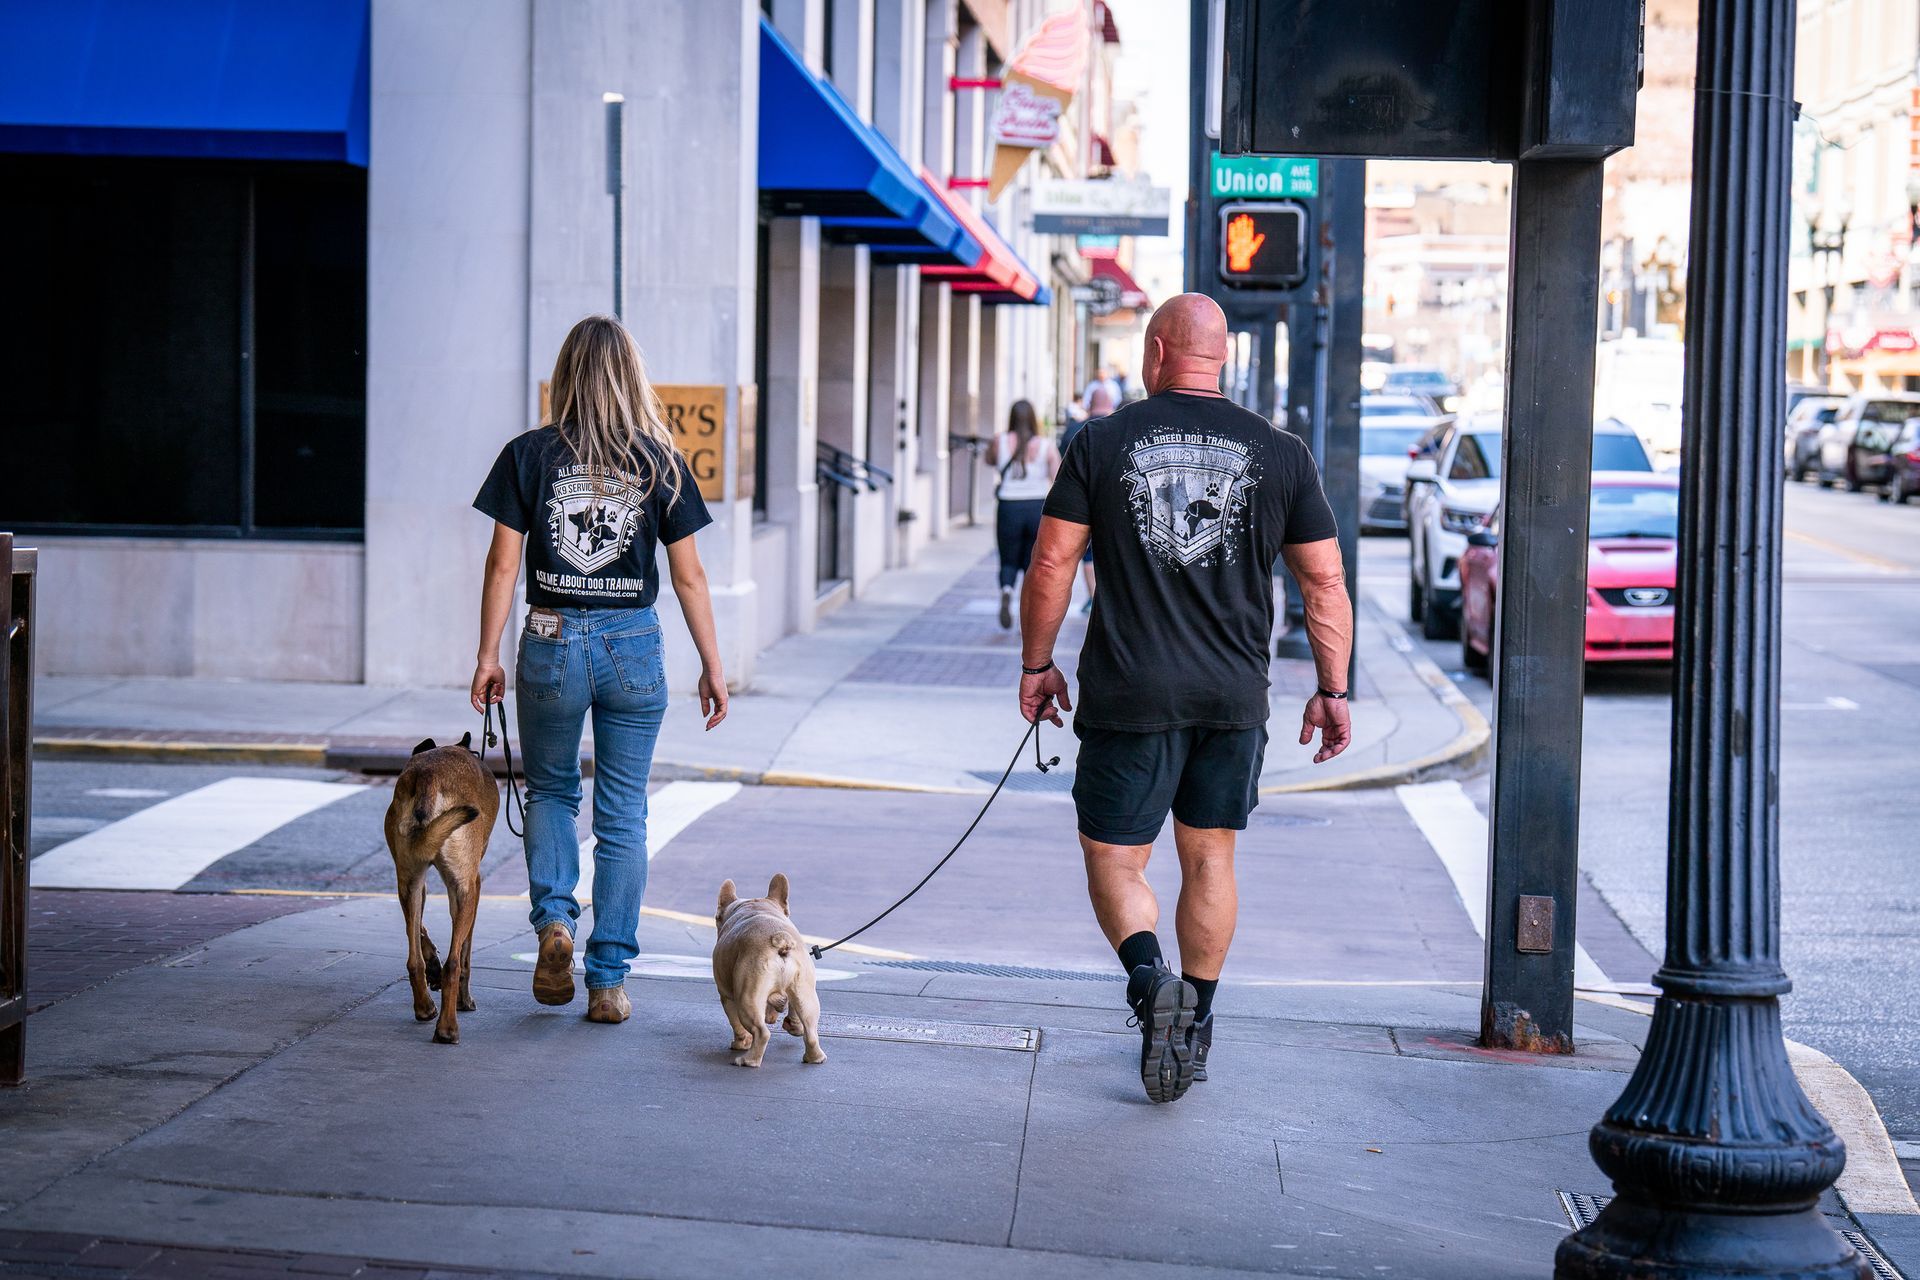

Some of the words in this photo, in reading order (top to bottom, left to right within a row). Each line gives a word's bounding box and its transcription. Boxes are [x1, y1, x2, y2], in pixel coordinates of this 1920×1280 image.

[1290, 164, 1310, 177] AVE
[1216, 167, 1283, 192] Union
[1134, 437, 1150, 450] ALL
[1153, 433, 1182, 444] BREED
[1184, 433, 1203, 444] DOG
[1206, 435, 1248, 455] TRAINING
[1138, 455, 1151, 468] K9
[1153, 451, 1195, 464] SERVICES
[1199, 451, 1245, 472] UNLIMITED
[558, 466, 571, 478] ALL
[557, 485, 567, 496] K9
[536, 570, 547, 583] ASK
[547, 573, 558, 586] ME
[560, 574, 586, 588] ABOUT
[587, 577, 603, 589] DOG
[605, 578, 643, 591] TRAINING
[540, 583, 637, 597] www.k9servicesunlimited.com
